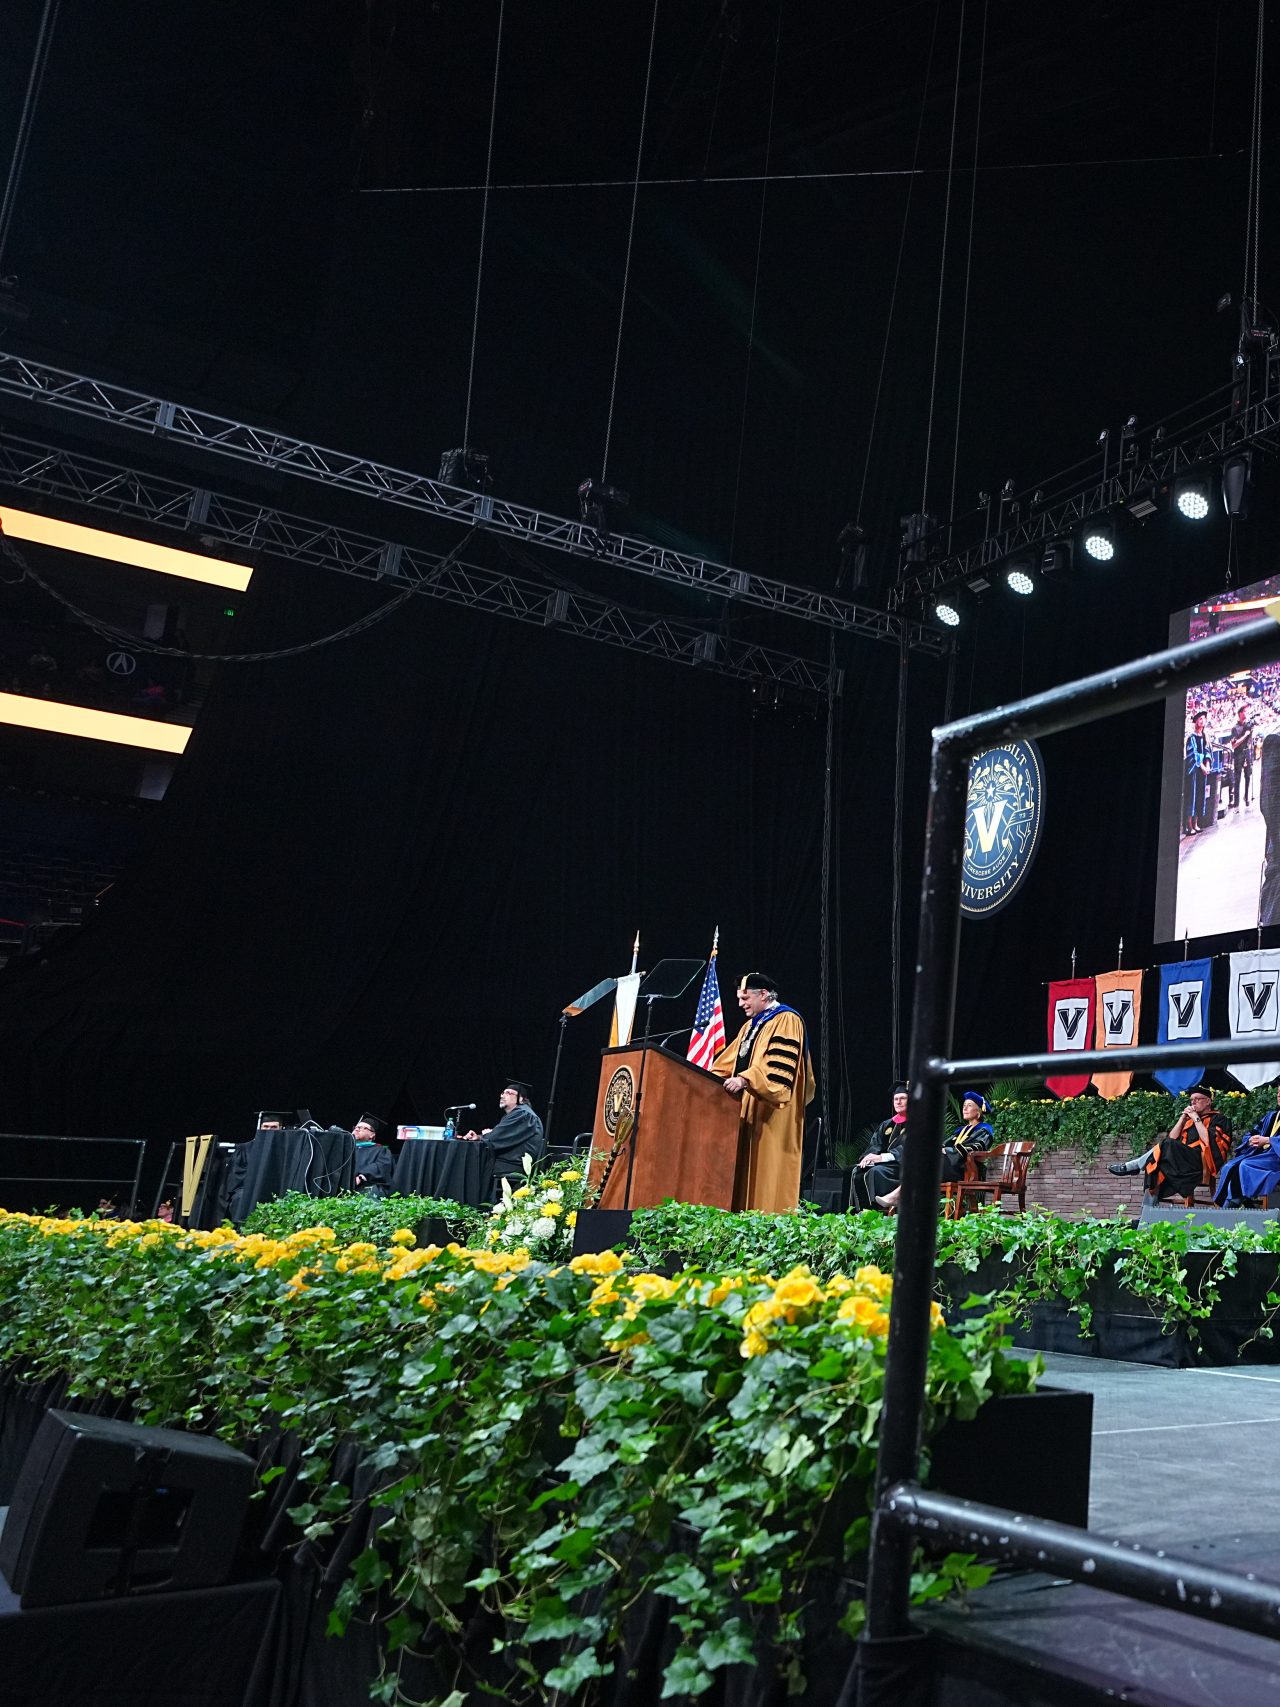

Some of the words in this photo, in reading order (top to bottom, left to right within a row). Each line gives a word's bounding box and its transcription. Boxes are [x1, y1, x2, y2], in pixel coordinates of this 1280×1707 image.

[972, 799, 1008, 853] V
[960, 854, 1020, 900] NIVERSITY
[1105, 1000, 1132, 1035] V
[1170, 990, 1201, 1029] V
[1241, 981, 1276, 1020] V
[1057, 1007, 1087, 1041] V
[182, 1135, 213, 1216] V
